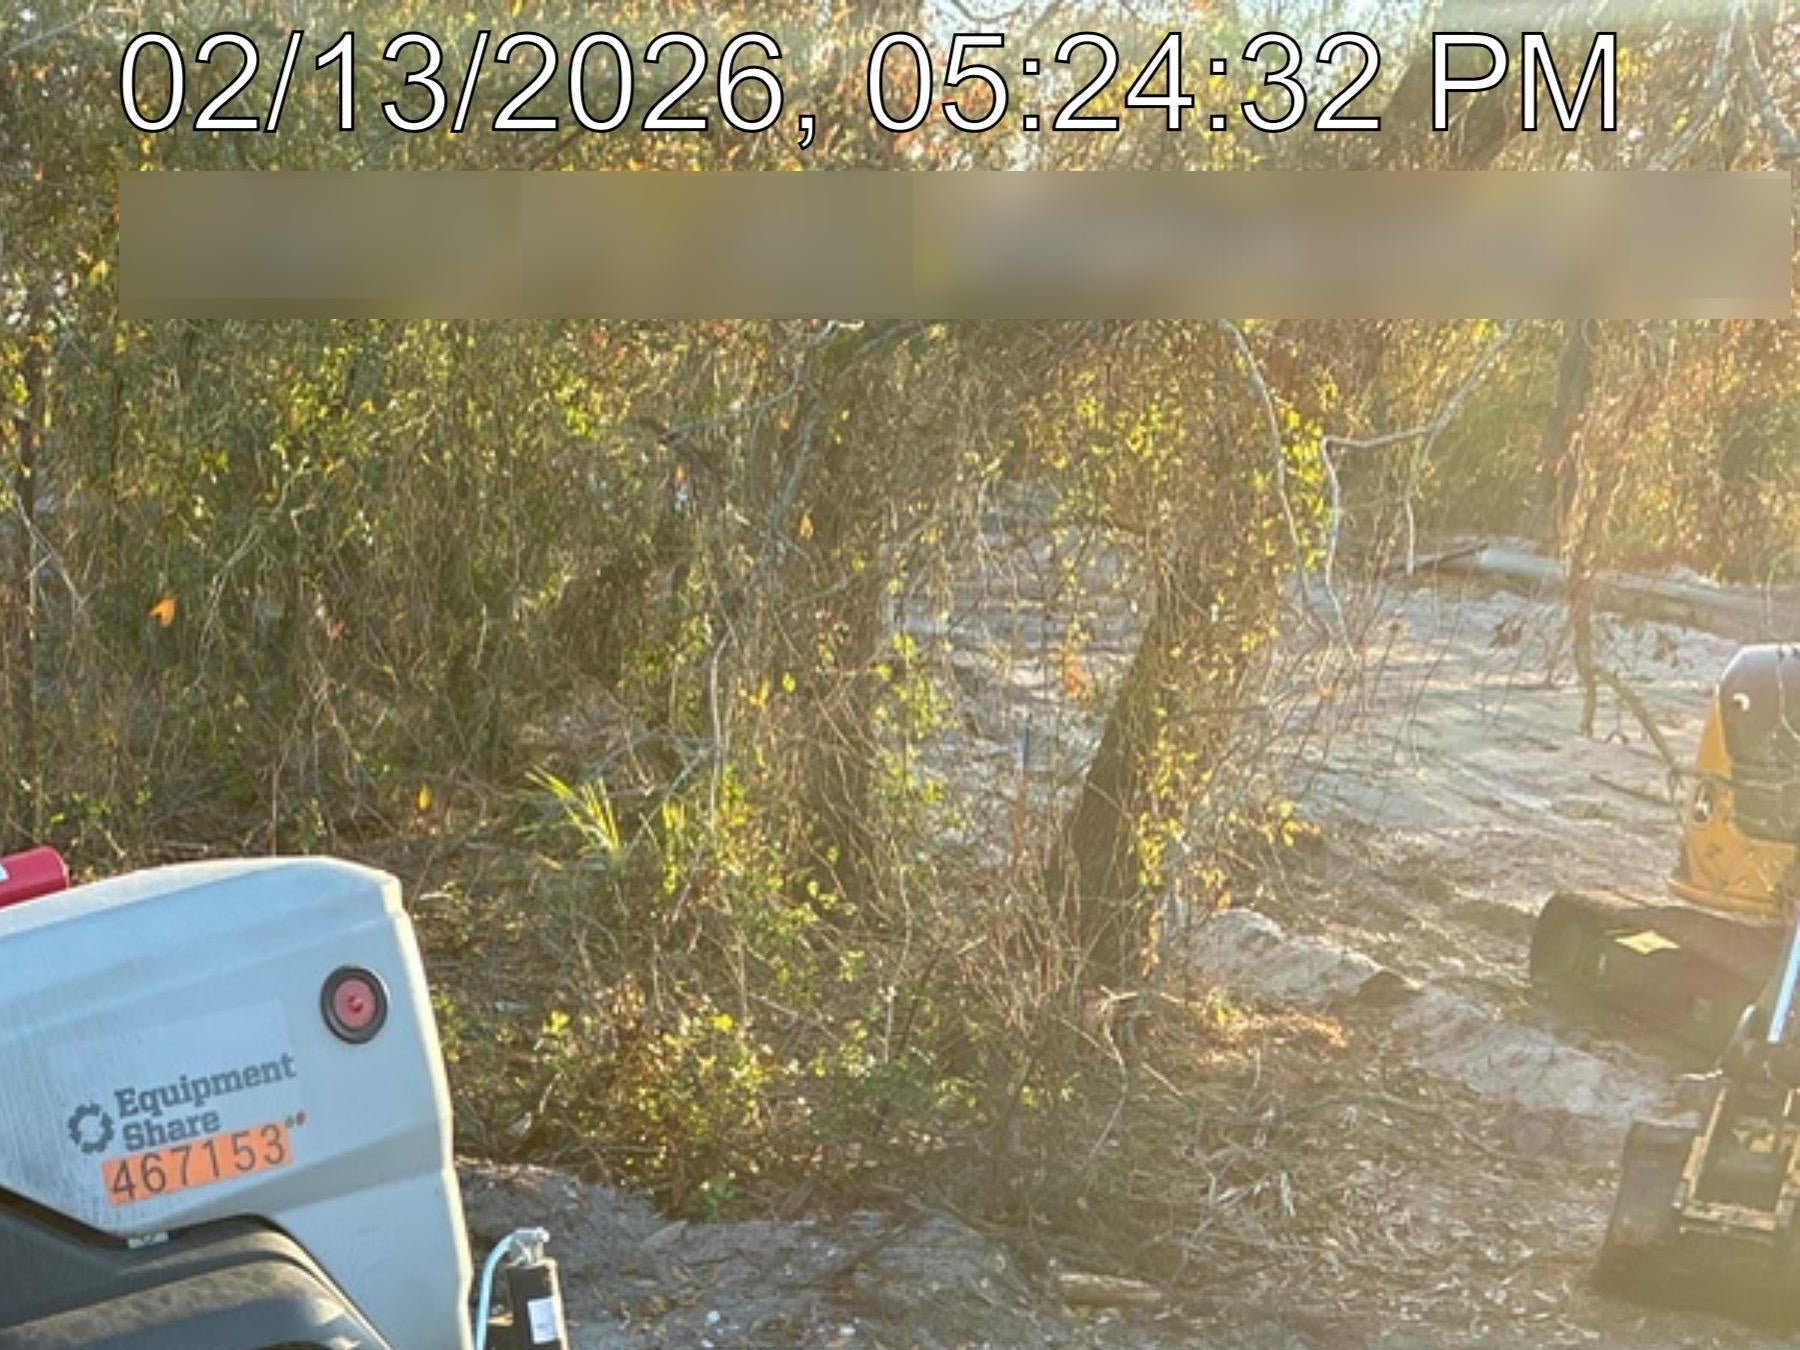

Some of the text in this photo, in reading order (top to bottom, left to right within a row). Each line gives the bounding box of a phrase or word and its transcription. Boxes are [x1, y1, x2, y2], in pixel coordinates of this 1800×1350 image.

[113, 1052, 297, 1118] Equipment
[111, 1123, 286, 1199] 467153
[122, 1110, 221, 1152] Share
